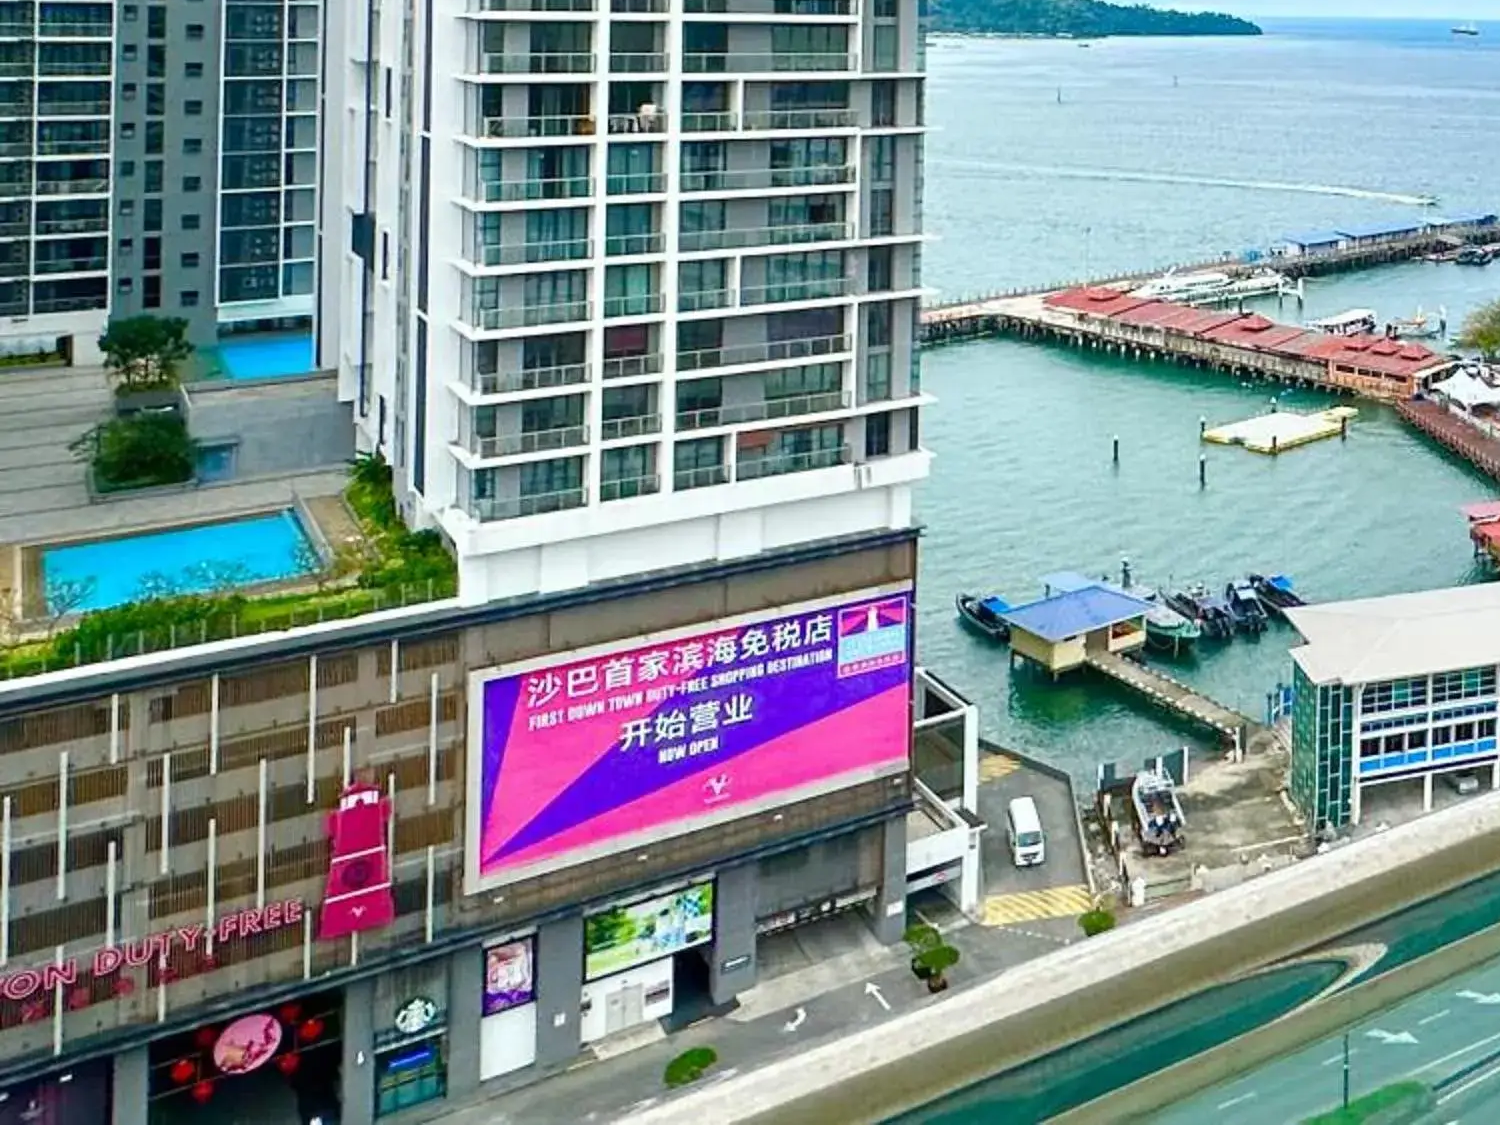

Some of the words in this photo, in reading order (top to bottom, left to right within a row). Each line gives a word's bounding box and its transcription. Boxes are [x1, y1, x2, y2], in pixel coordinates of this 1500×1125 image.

[527, 615, 833, 708] 沙巴首家滨海免税店
[528, 708, 564, 732] FIRST
[608, 690, 644, 712] TOWN
[618, 693, 753, 752] 开始营业
[658, 742, 687, 764] NOW
[689, 735, 719, 756] OPEN
[0, 958, 77, 1000] ON
